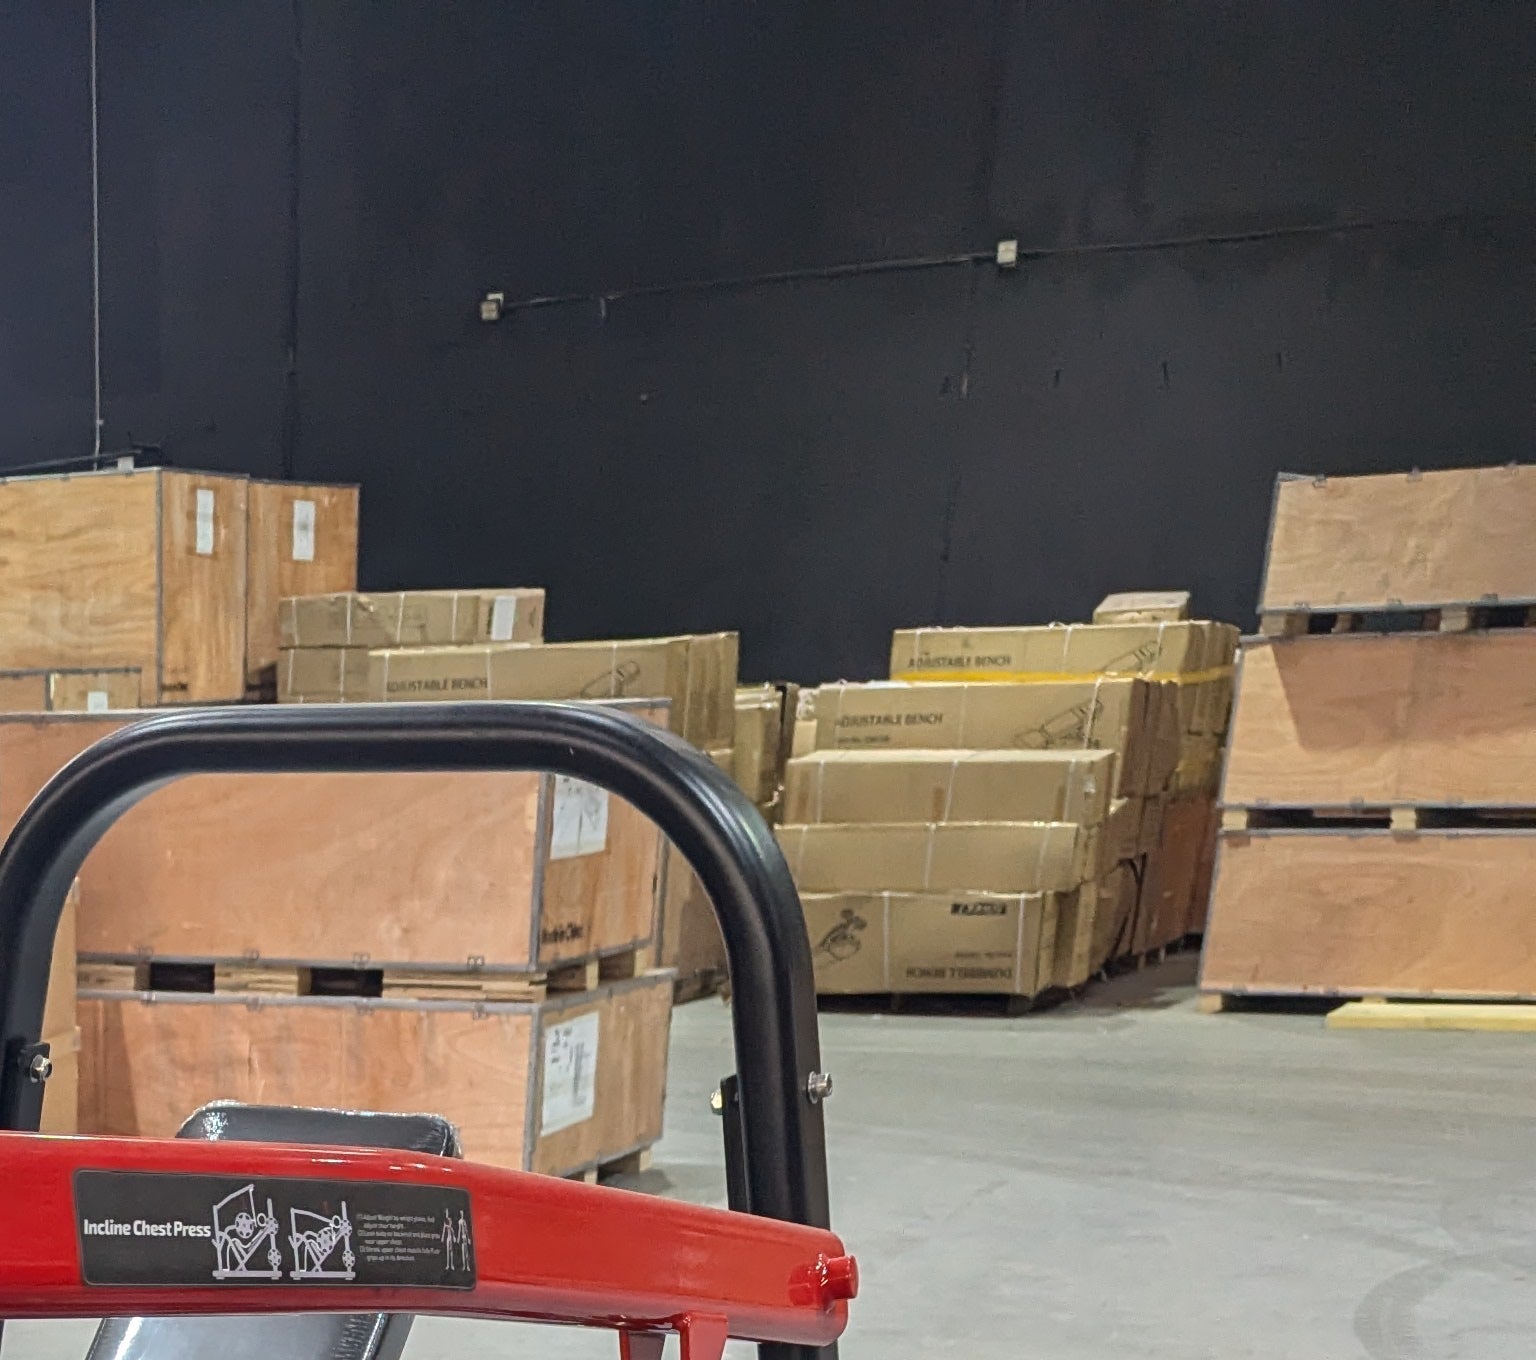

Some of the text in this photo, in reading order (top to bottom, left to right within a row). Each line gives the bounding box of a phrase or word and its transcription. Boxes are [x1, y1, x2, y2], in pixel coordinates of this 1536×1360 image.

[974, 654, 1012, 668] BENCH
[905, 712, 944, 726] BENCH
[83, 1219, 212, 1238] Incline Chest Press
